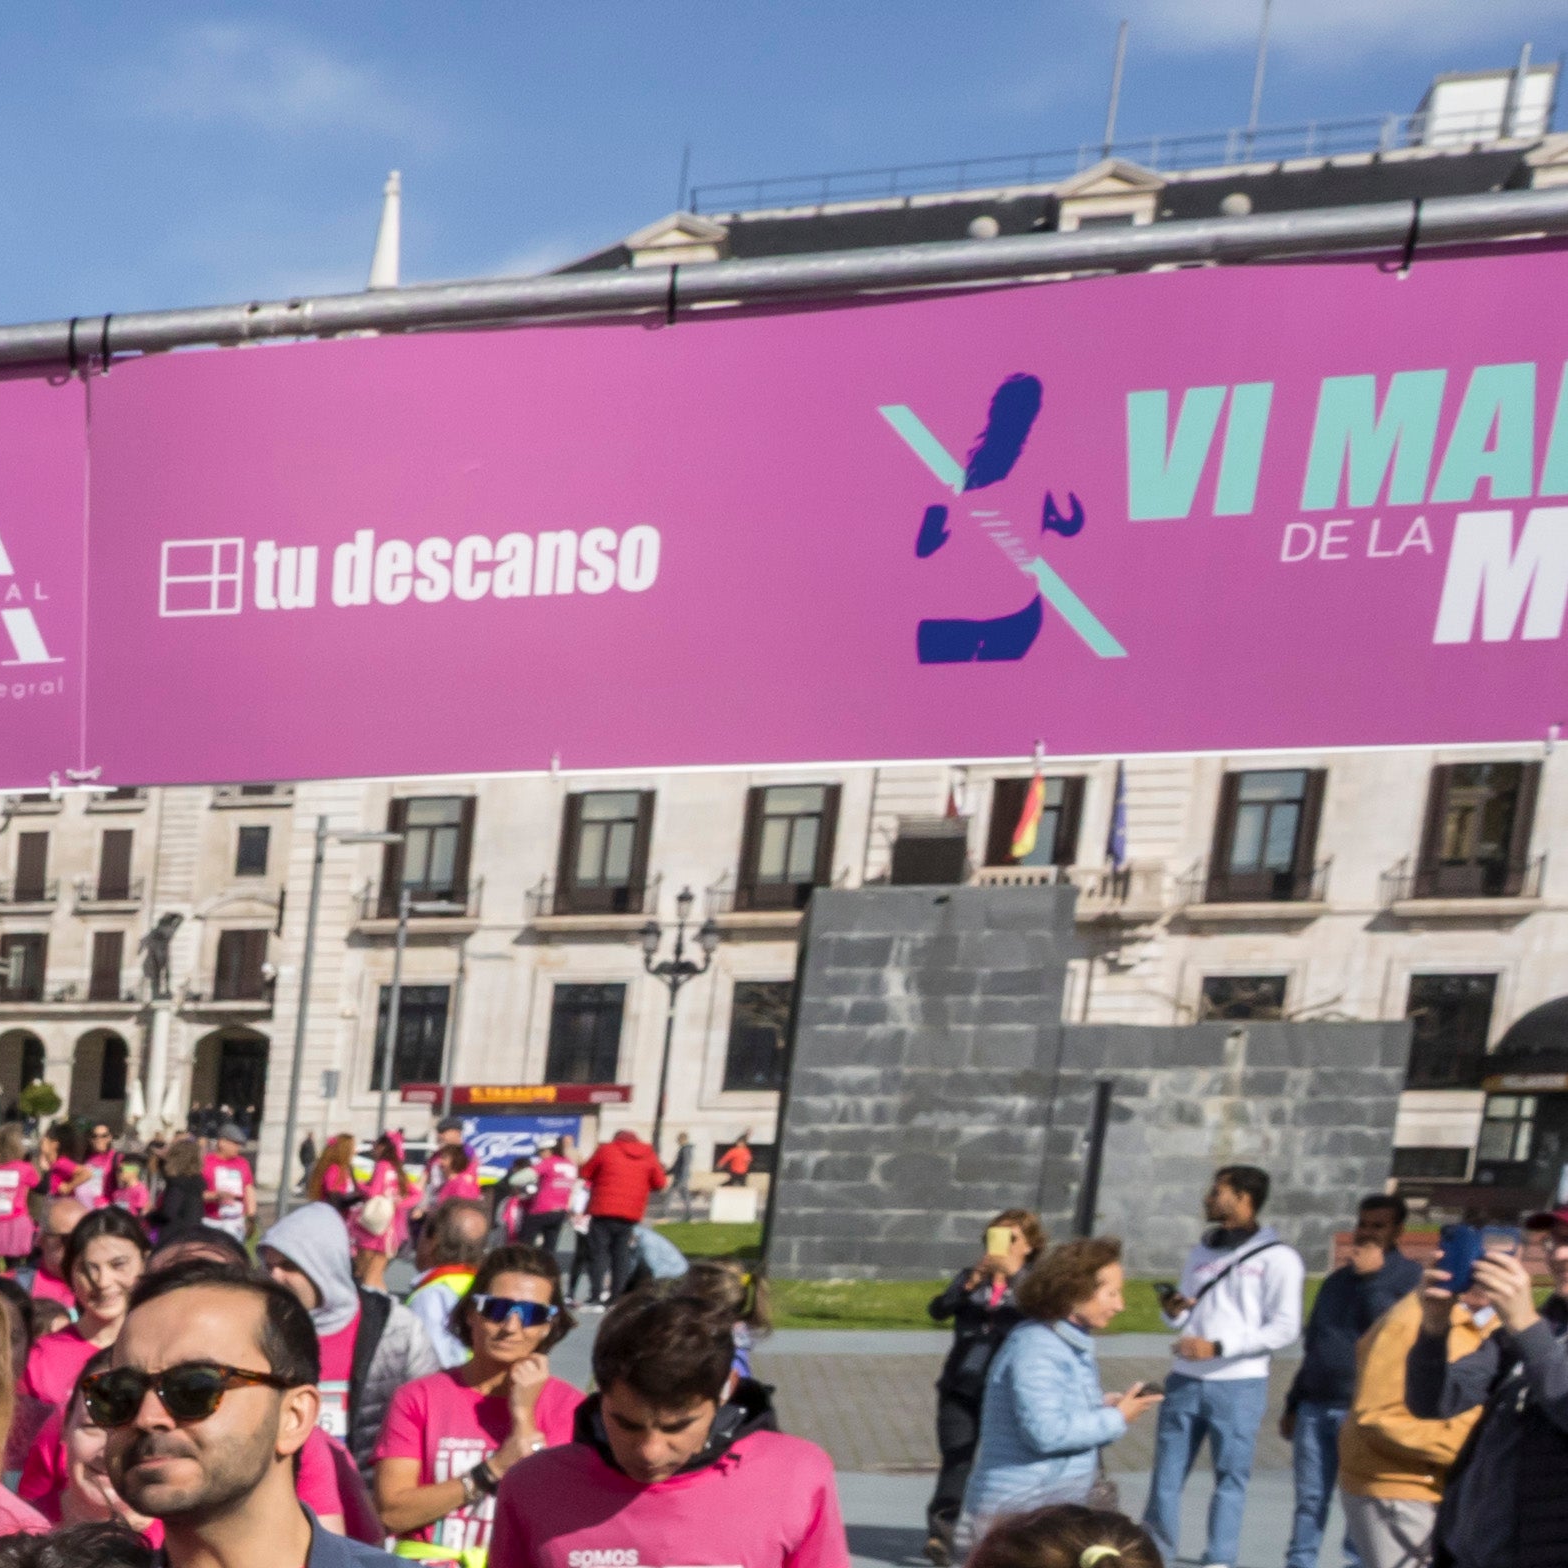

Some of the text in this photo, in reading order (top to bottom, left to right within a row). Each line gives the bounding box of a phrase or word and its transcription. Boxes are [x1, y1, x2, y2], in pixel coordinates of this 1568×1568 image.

[1127, 382, 1274, 521] VI
[254, 524, 661, 611] tu descanso
[1280, 520, 1354, 563] DE
[1365, 516, 1434, 558] LA
